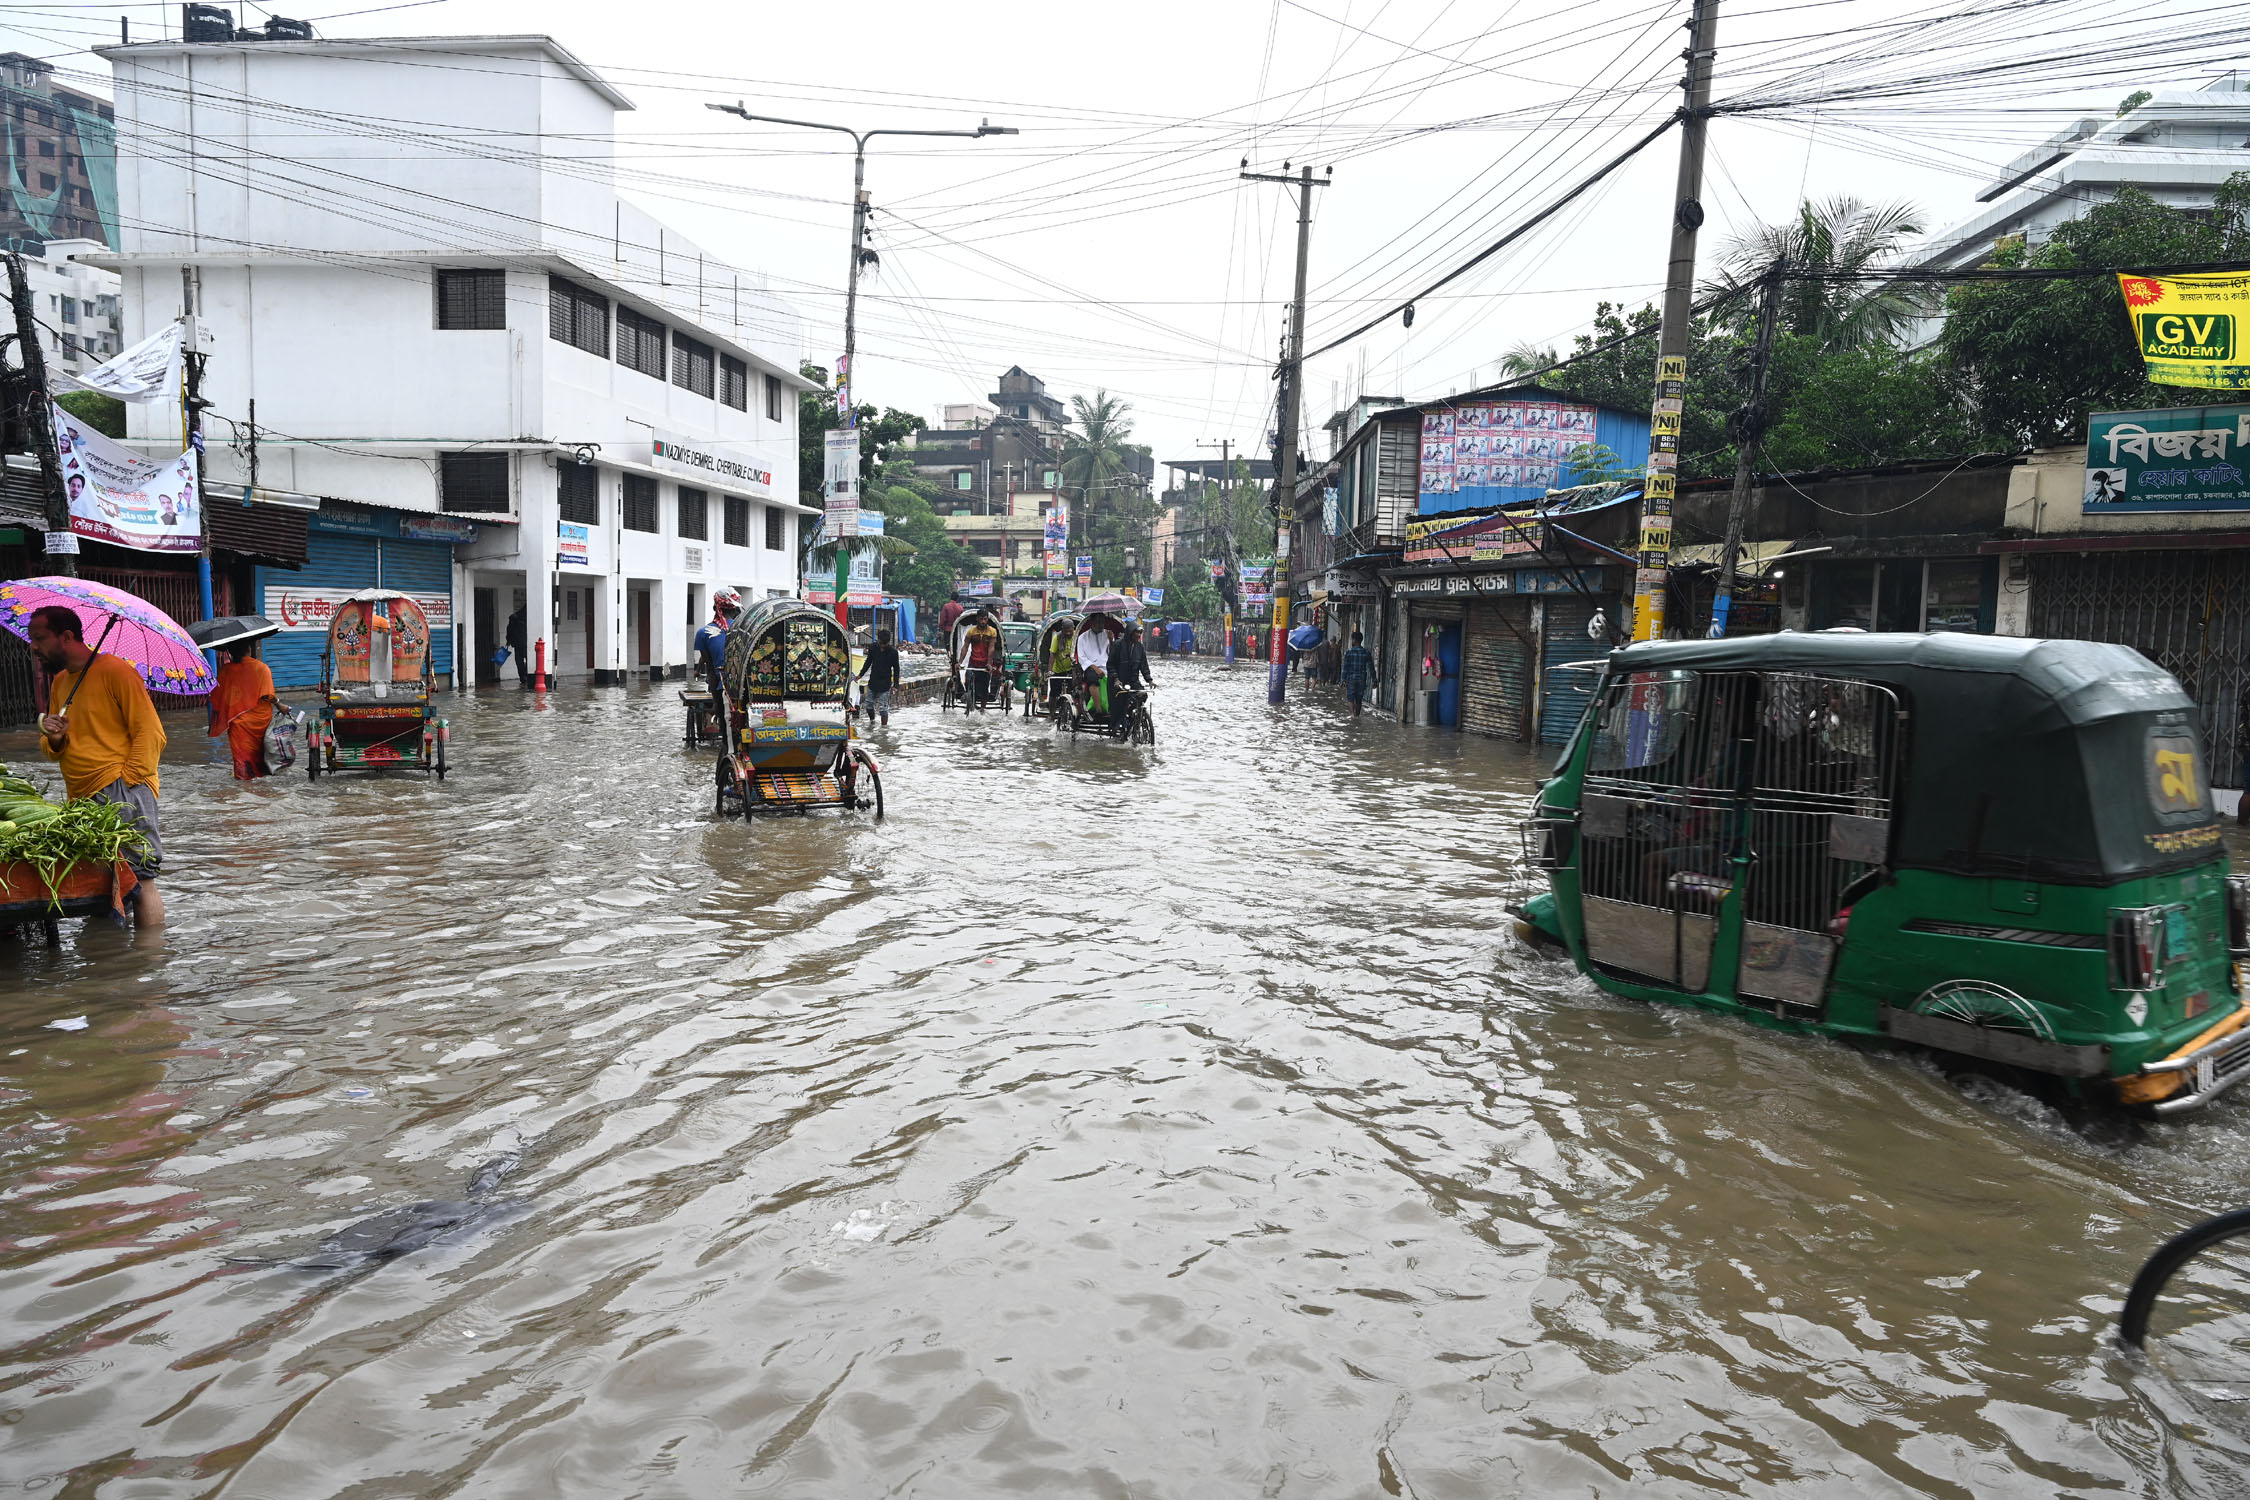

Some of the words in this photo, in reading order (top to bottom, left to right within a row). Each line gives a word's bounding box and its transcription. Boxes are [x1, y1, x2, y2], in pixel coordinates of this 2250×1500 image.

[2230, 278, 2248, 288] ICT
[2178, 293, 2203, 301] জামাল
[2204, 293, 2221, 301] স্যার
[2155, 315, 2215, 345] GV
[2147, 344, 2225, 357] ACADEMY
[2102, 423, 2234, 464] বিজয়
[2138, 468, 2190, 489] হেয়ার
[2192, 463, 2244, 485] কাটিং
[1394, 577, 1442, 593] লোকনাথ
[2155, 749, 2199, 806] মা
